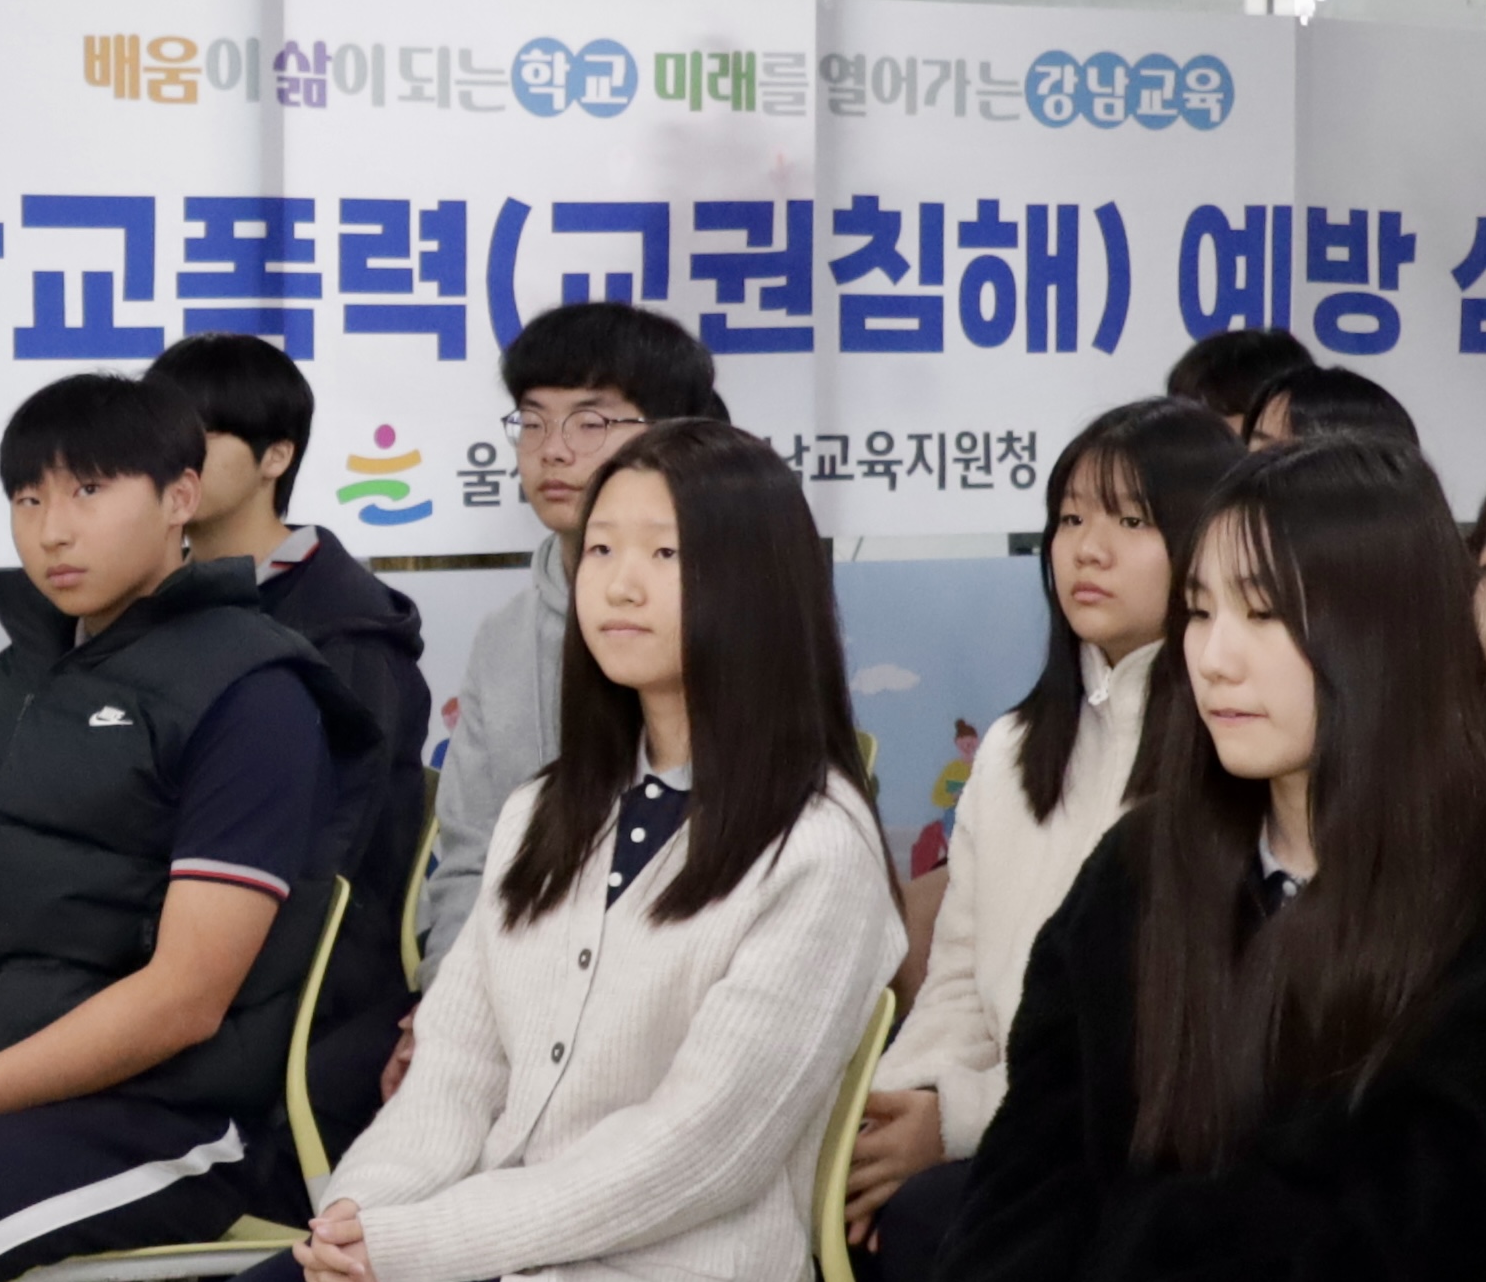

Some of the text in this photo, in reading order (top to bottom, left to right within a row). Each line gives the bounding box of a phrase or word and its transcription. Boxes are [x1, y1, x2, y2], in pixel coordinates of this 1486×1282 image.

[83, 33, 1225, 124] 배움이 삶이 되는 학교 미래를 열어가는 강남교육
[1178, 204, 1416, 355] 예방
